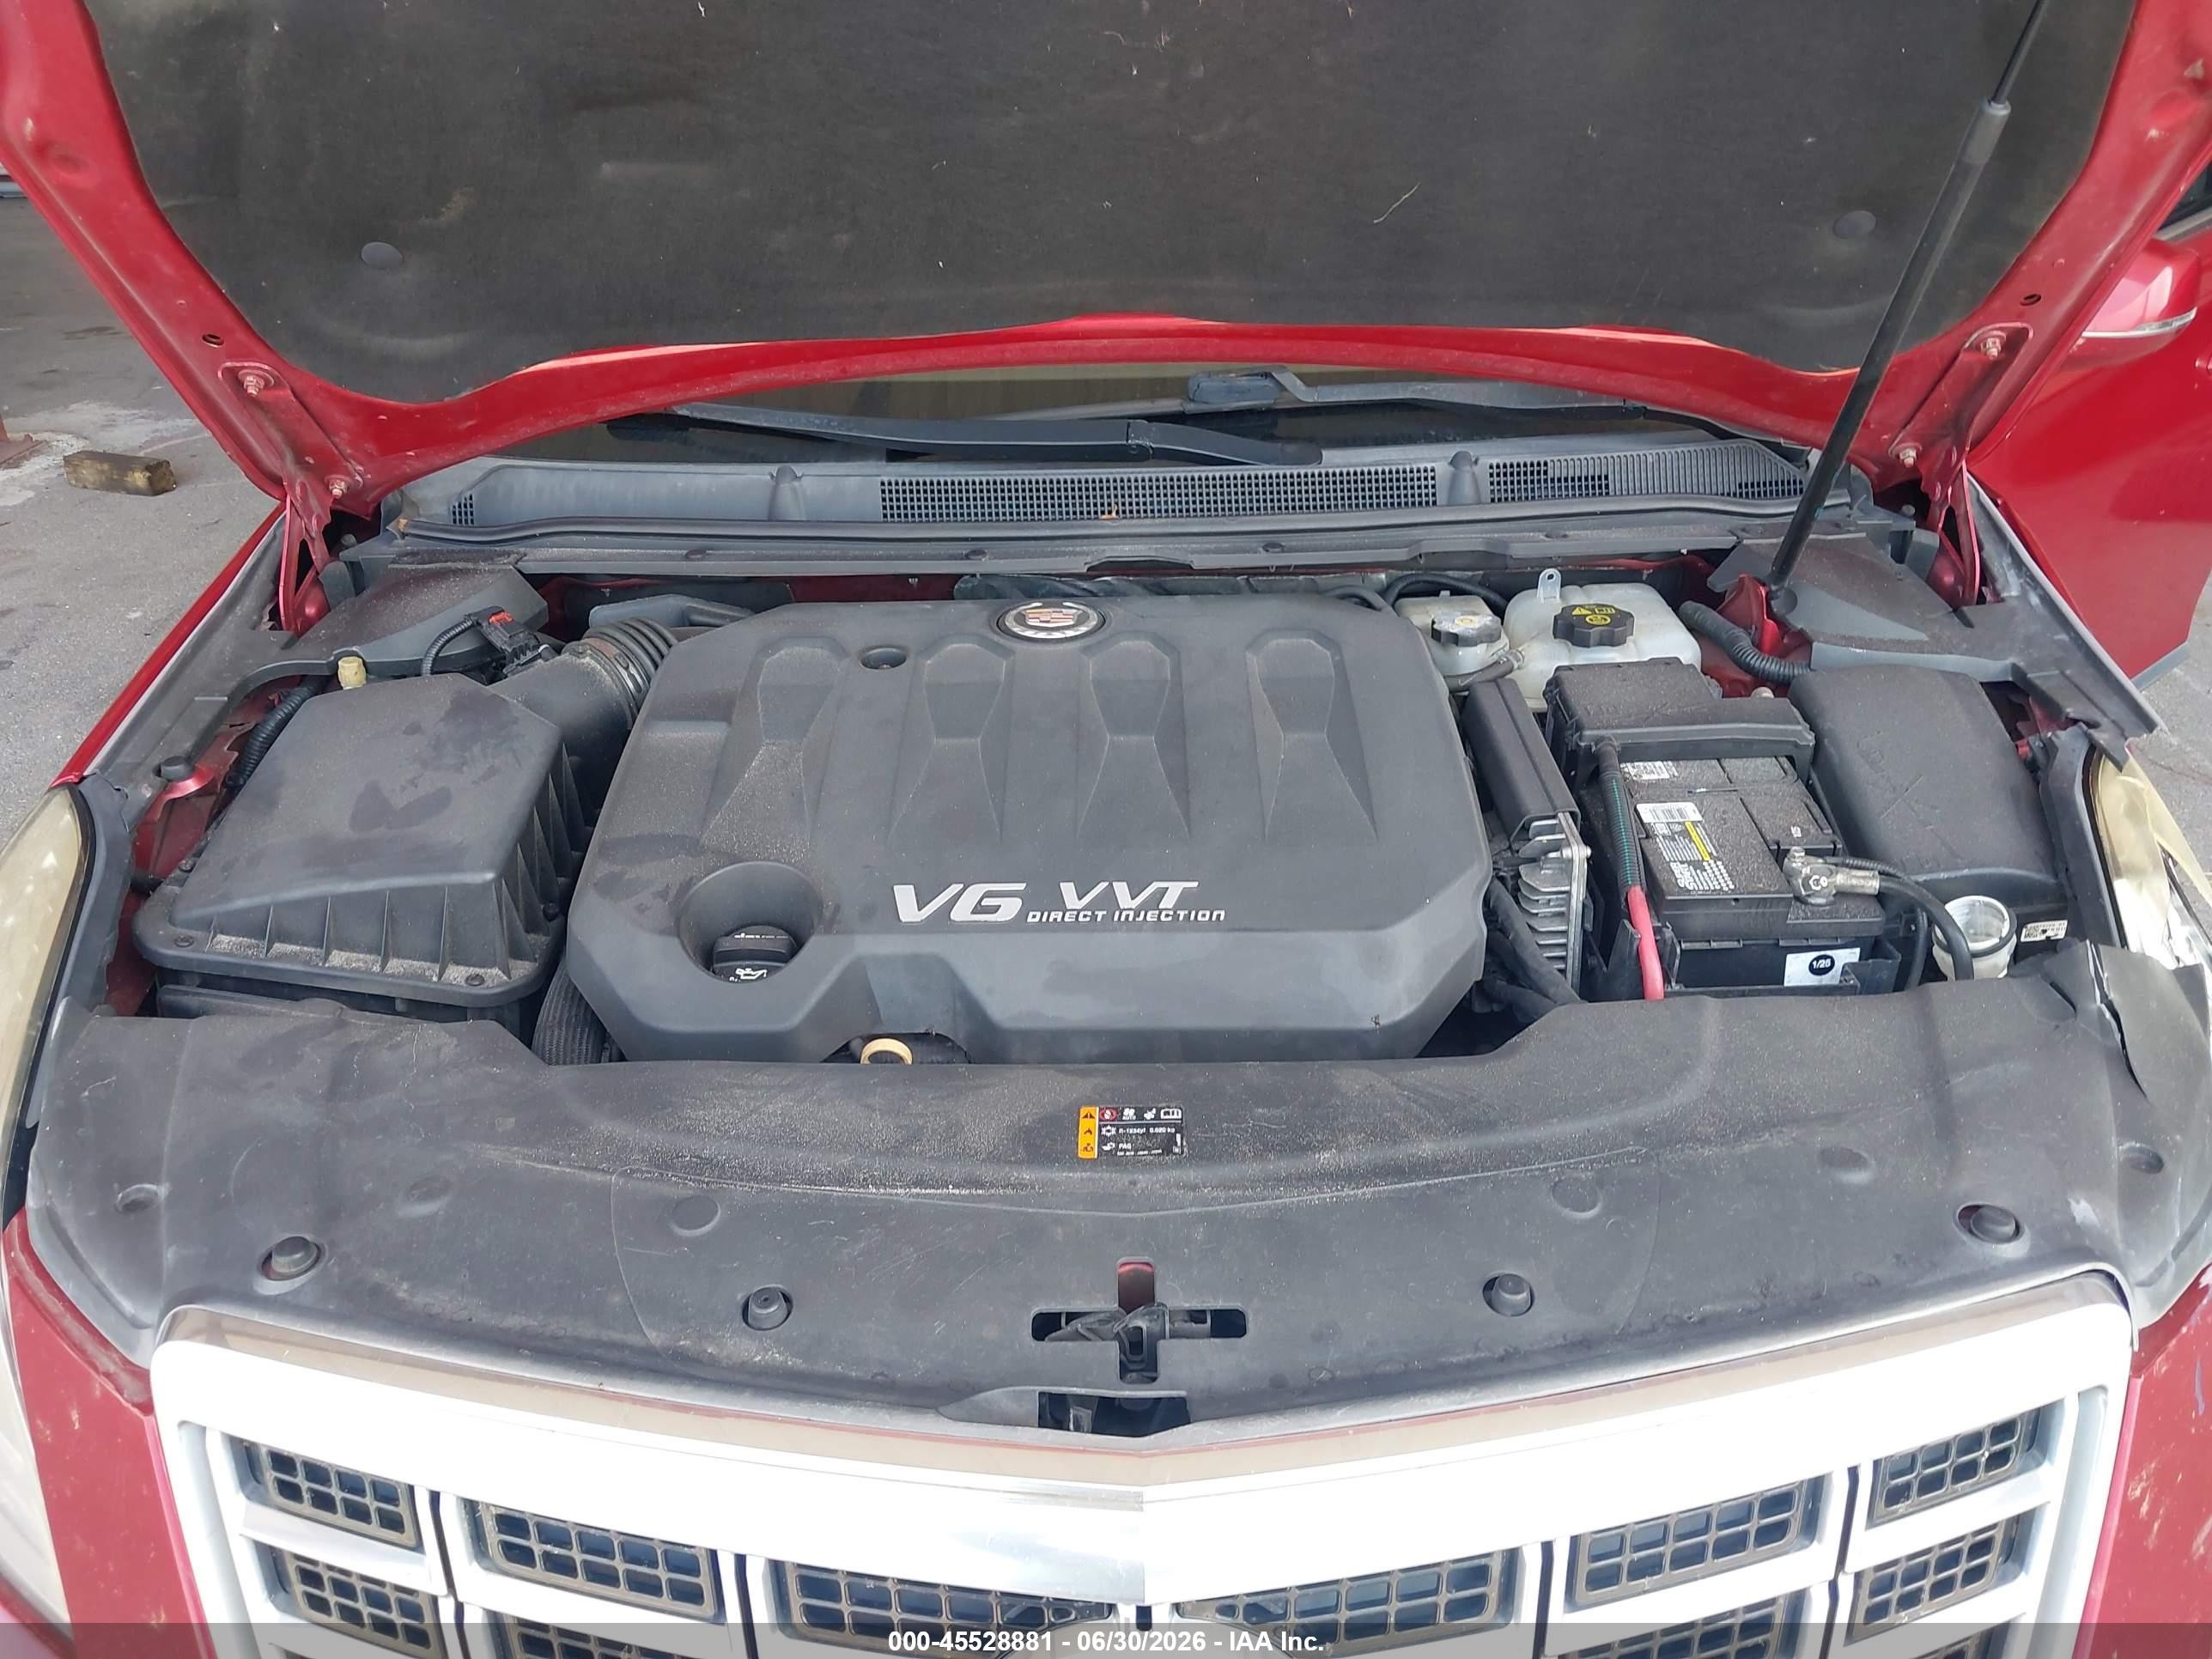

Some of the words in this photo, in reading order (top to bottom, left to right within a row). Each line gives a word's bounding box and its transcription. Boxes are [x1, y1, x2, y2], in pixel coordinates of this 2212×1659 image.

[893, 883, 1026, 923] V6
[1058, 881, 1200, 909] VVT
[1026, 909, 1109, 923] DIRECT
